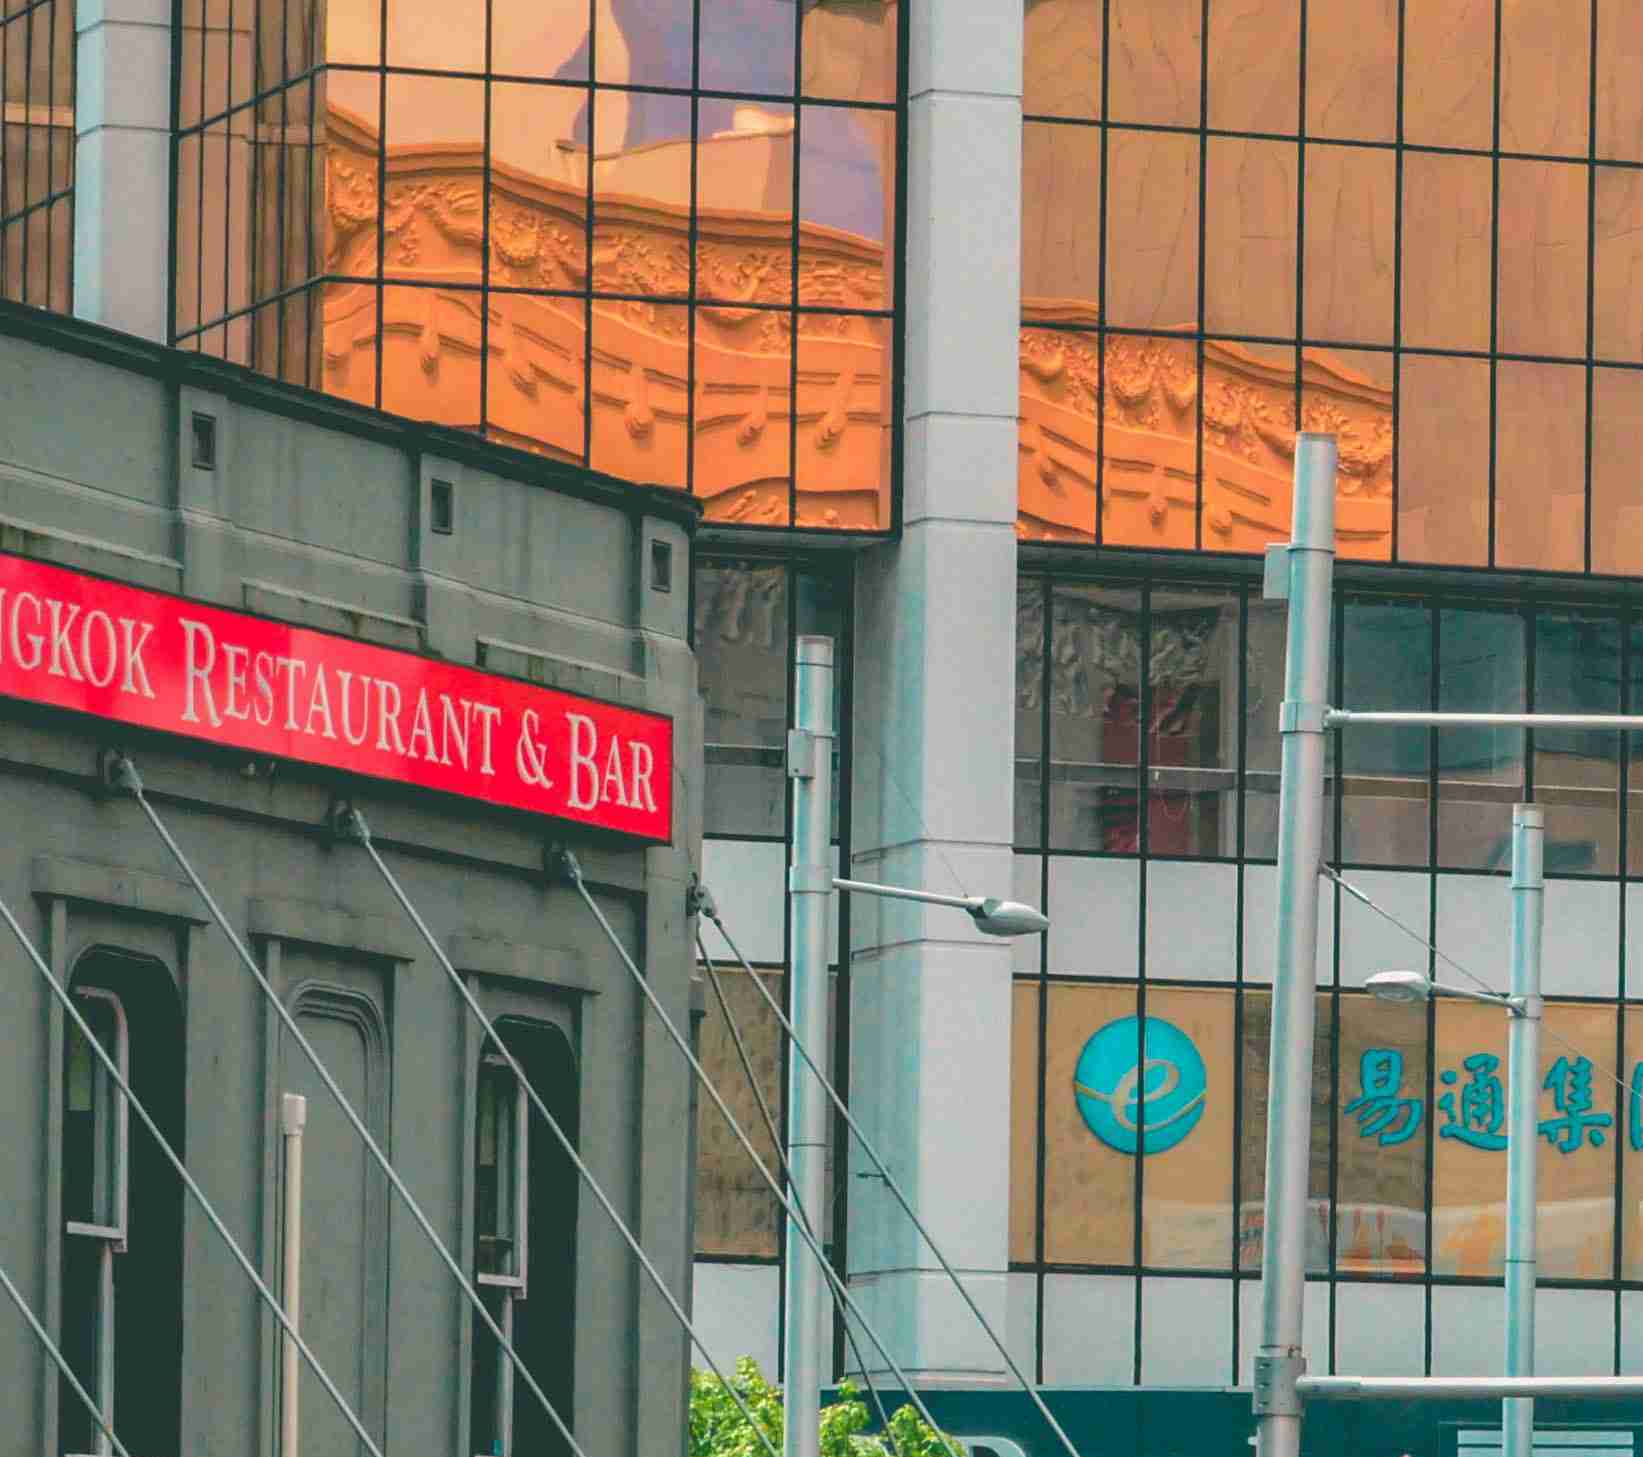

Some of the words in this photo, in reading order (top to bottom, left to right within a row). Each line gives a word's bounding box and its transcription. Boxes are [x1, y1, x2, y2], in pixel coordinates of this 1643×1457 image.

[0, 588, 156, 700] GKOK
[178, 616, 502, 779] RESTAURANT
[514, 709, 552, 790] &
[567, 710, 657, 813] BAR
